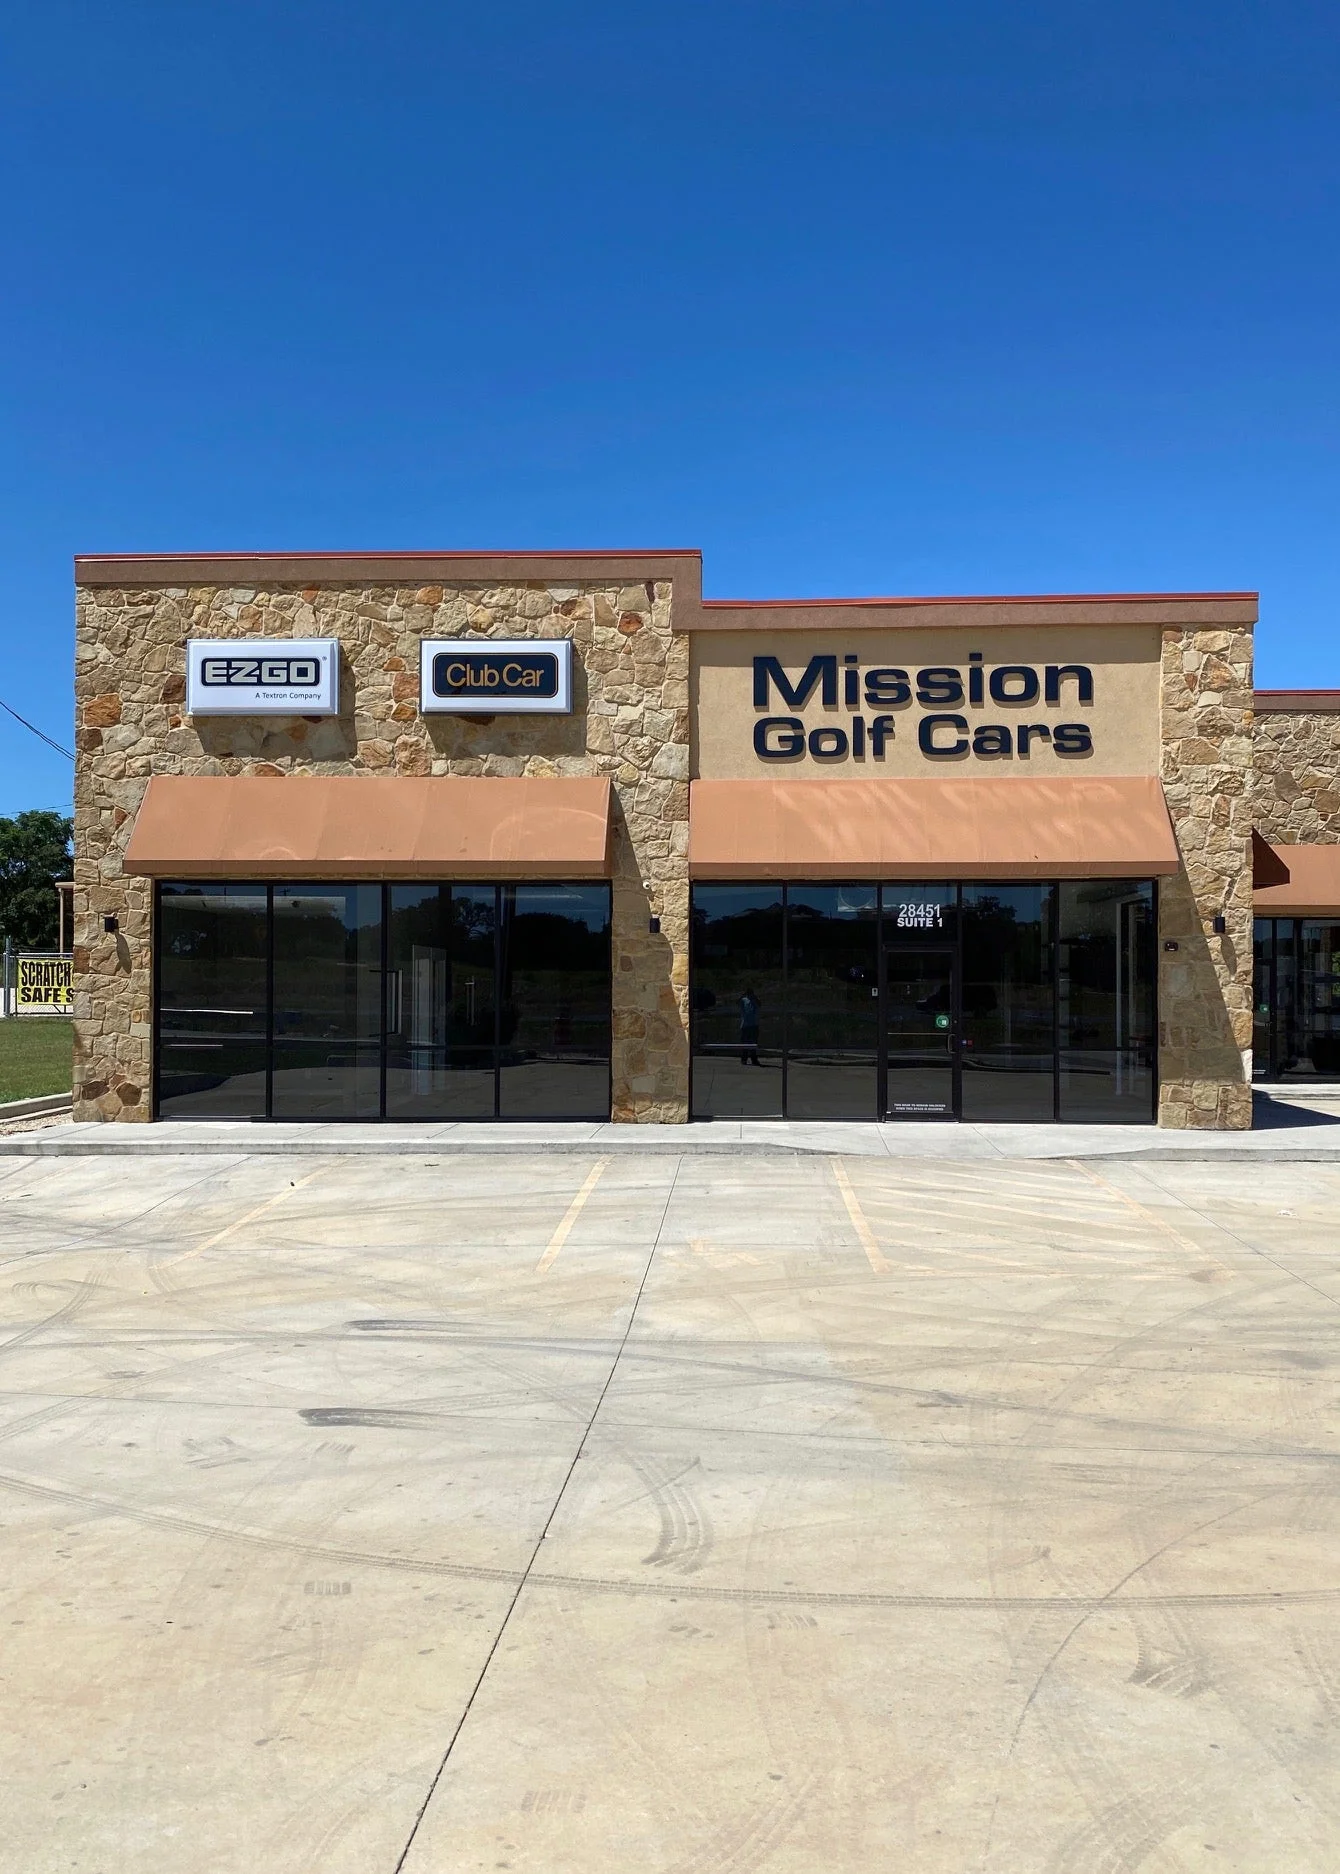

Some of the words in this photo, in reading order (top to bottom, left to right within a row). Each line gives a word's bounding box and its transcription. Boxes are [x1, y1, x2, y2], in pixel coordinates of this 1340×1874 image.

[446, 663, 500, 687] Club
[502, 663, 544, 687] Car
[753, 653, 1093, 706] Mission
[289, 692, 321, 700] Company
[753, 714, 894, 758] Golf
[918, 713, 1093, 756] Cars
[898, 903, 940, 918] 28451
[897, 917, 933, 927] SUITE
[937, 917, 943, 927] 1
[21, 961, 71, 987] SCRATCH
[21, 987, 61, 1003] SAFE
